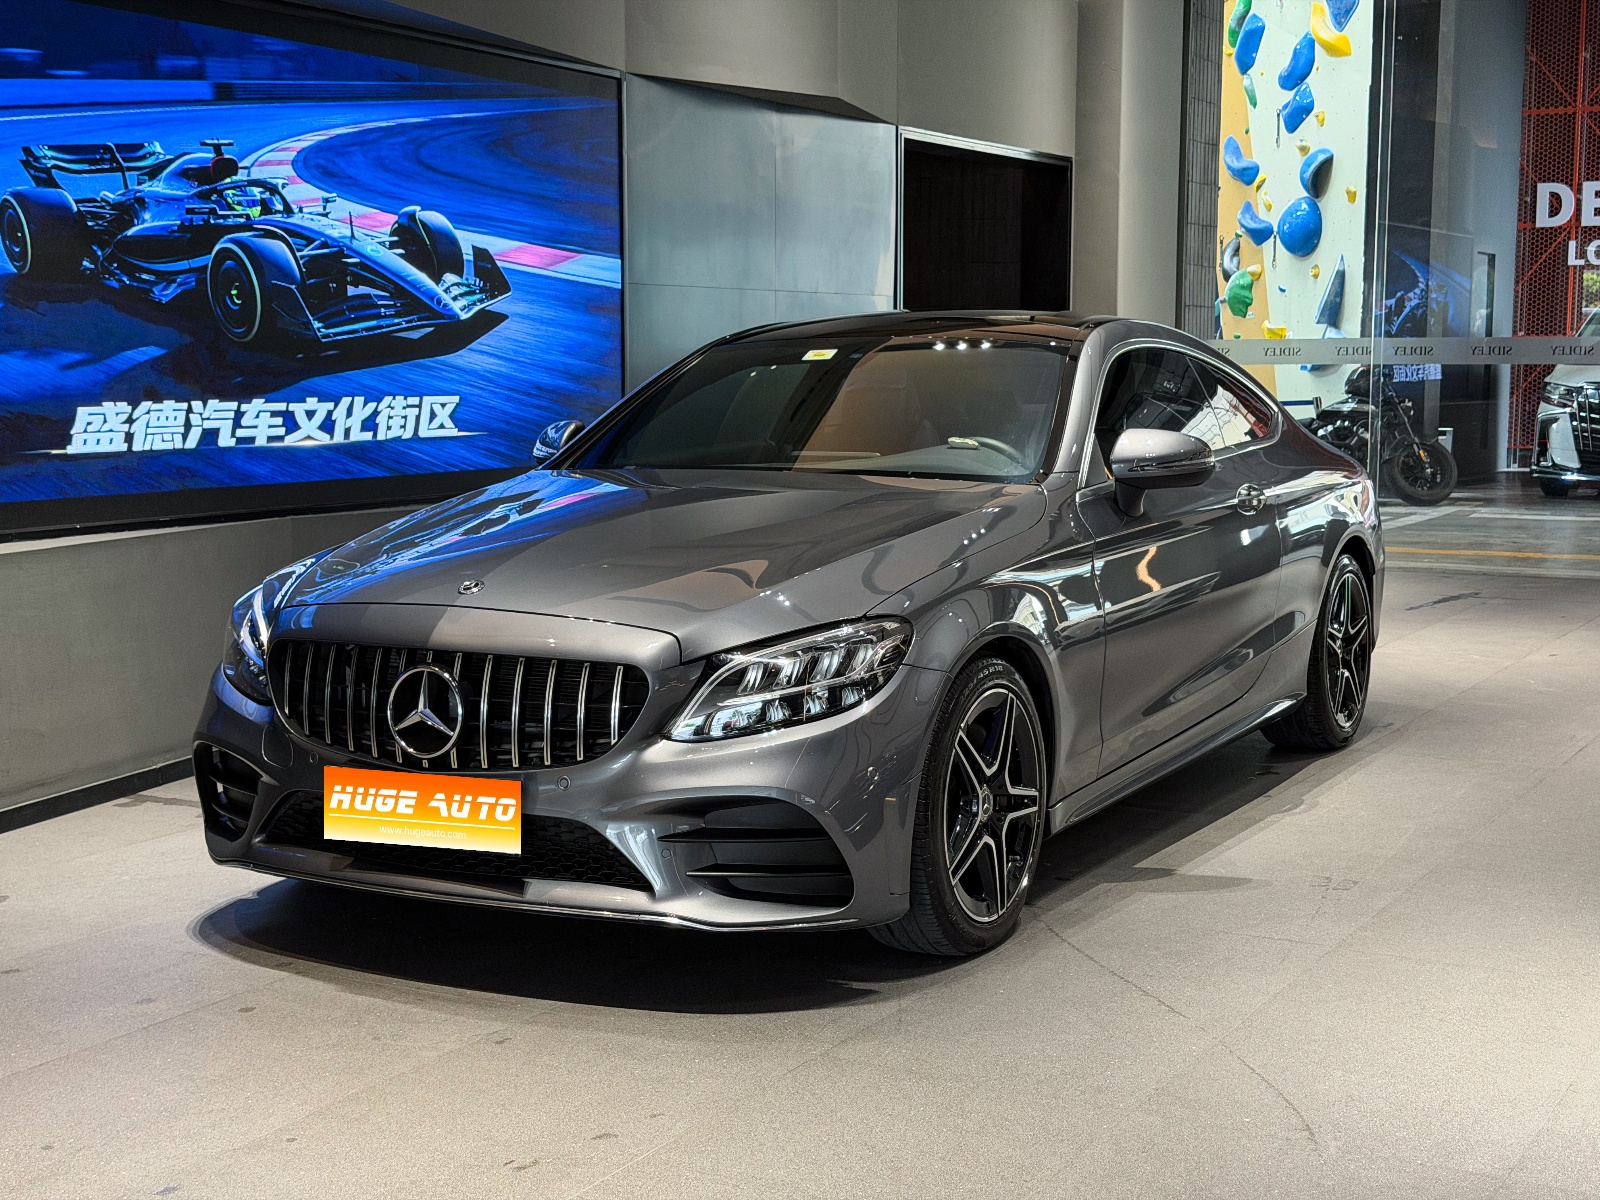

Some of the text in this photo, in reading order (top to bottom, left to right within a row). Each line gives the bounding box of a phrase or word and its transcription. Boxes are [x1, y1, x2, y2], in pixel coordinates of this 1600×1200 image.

[66, 395, 460, 454] 盛德汽车文化街区
